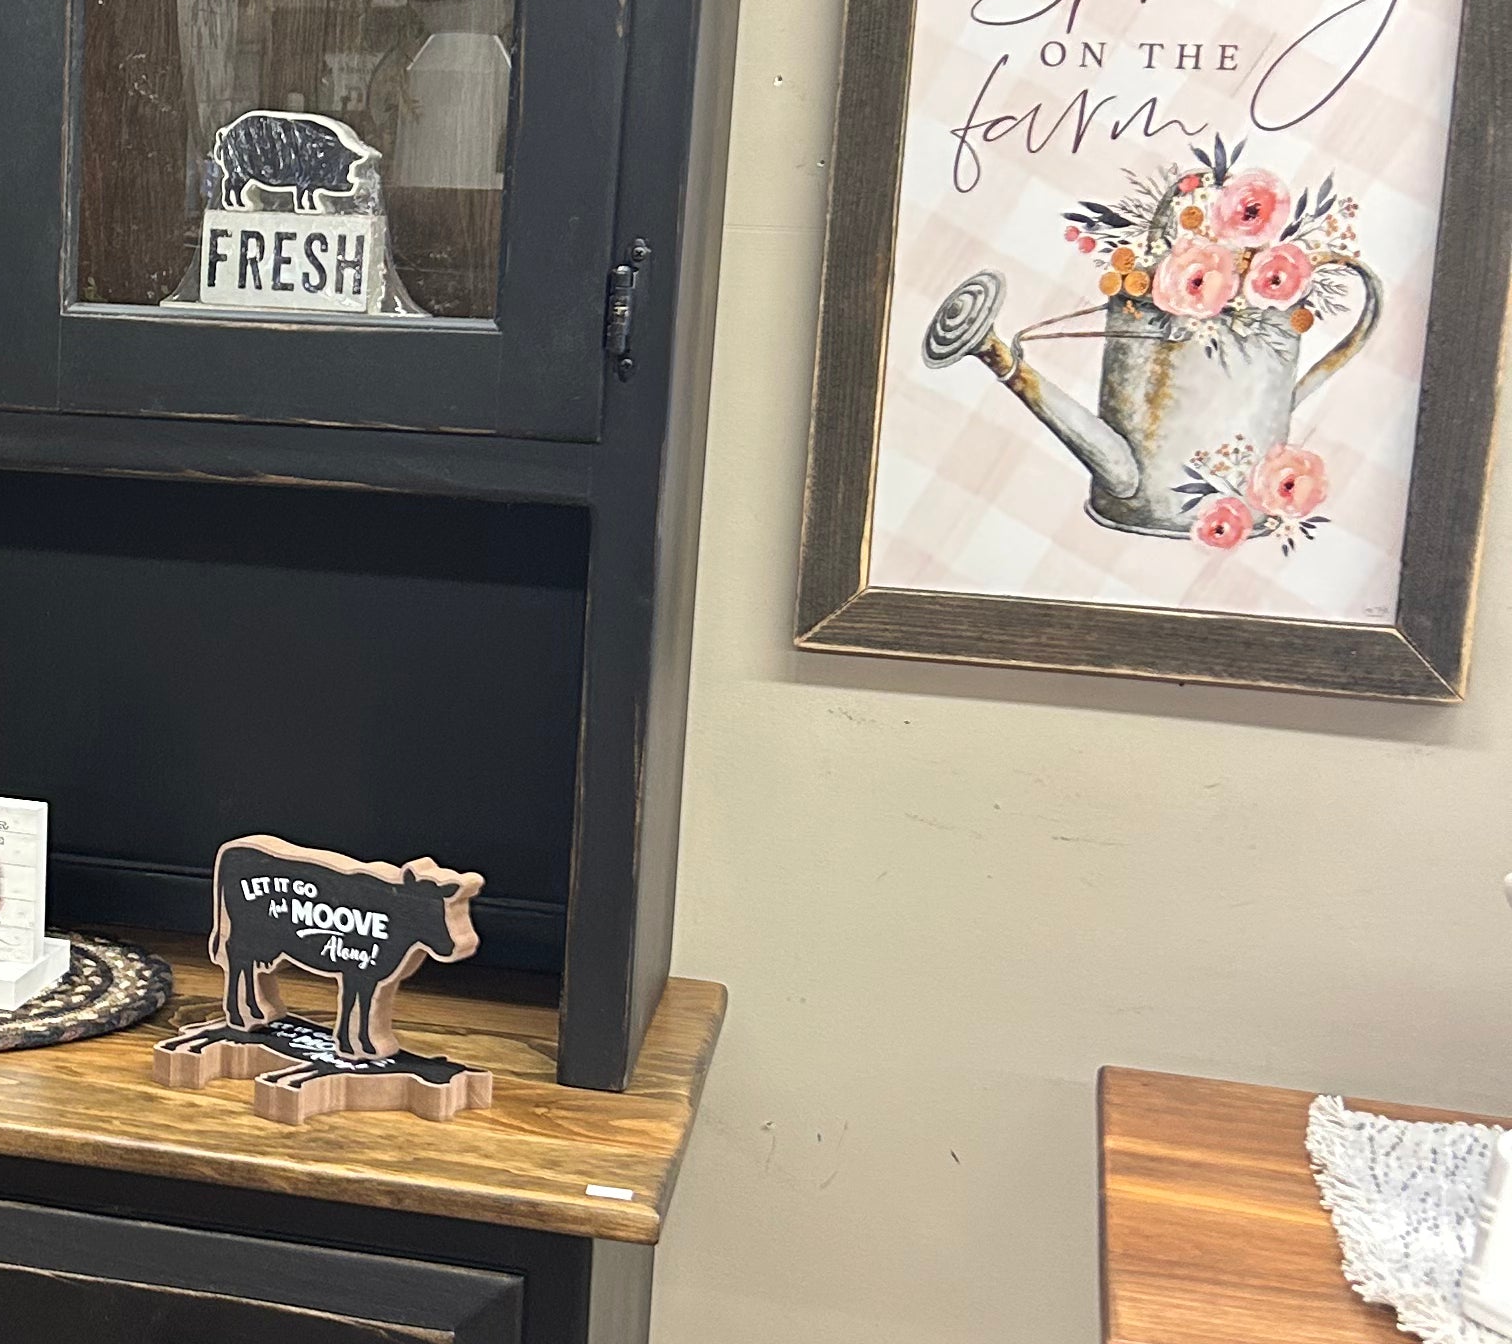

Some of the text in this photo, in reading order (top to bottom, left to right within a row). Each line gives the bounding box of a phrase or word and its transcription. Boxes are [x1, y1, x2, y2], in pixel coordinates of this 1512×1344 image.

[1039, 40, 1240, 73] ON THE
[950, 54, 1210, 193] farm
[207, 229, 364, 295] FRESH
[240, 876, 318, 901] LET IT GO
[269, 898, 388, 940] And MOOVE
[320, 935, 379, 970] Along!
